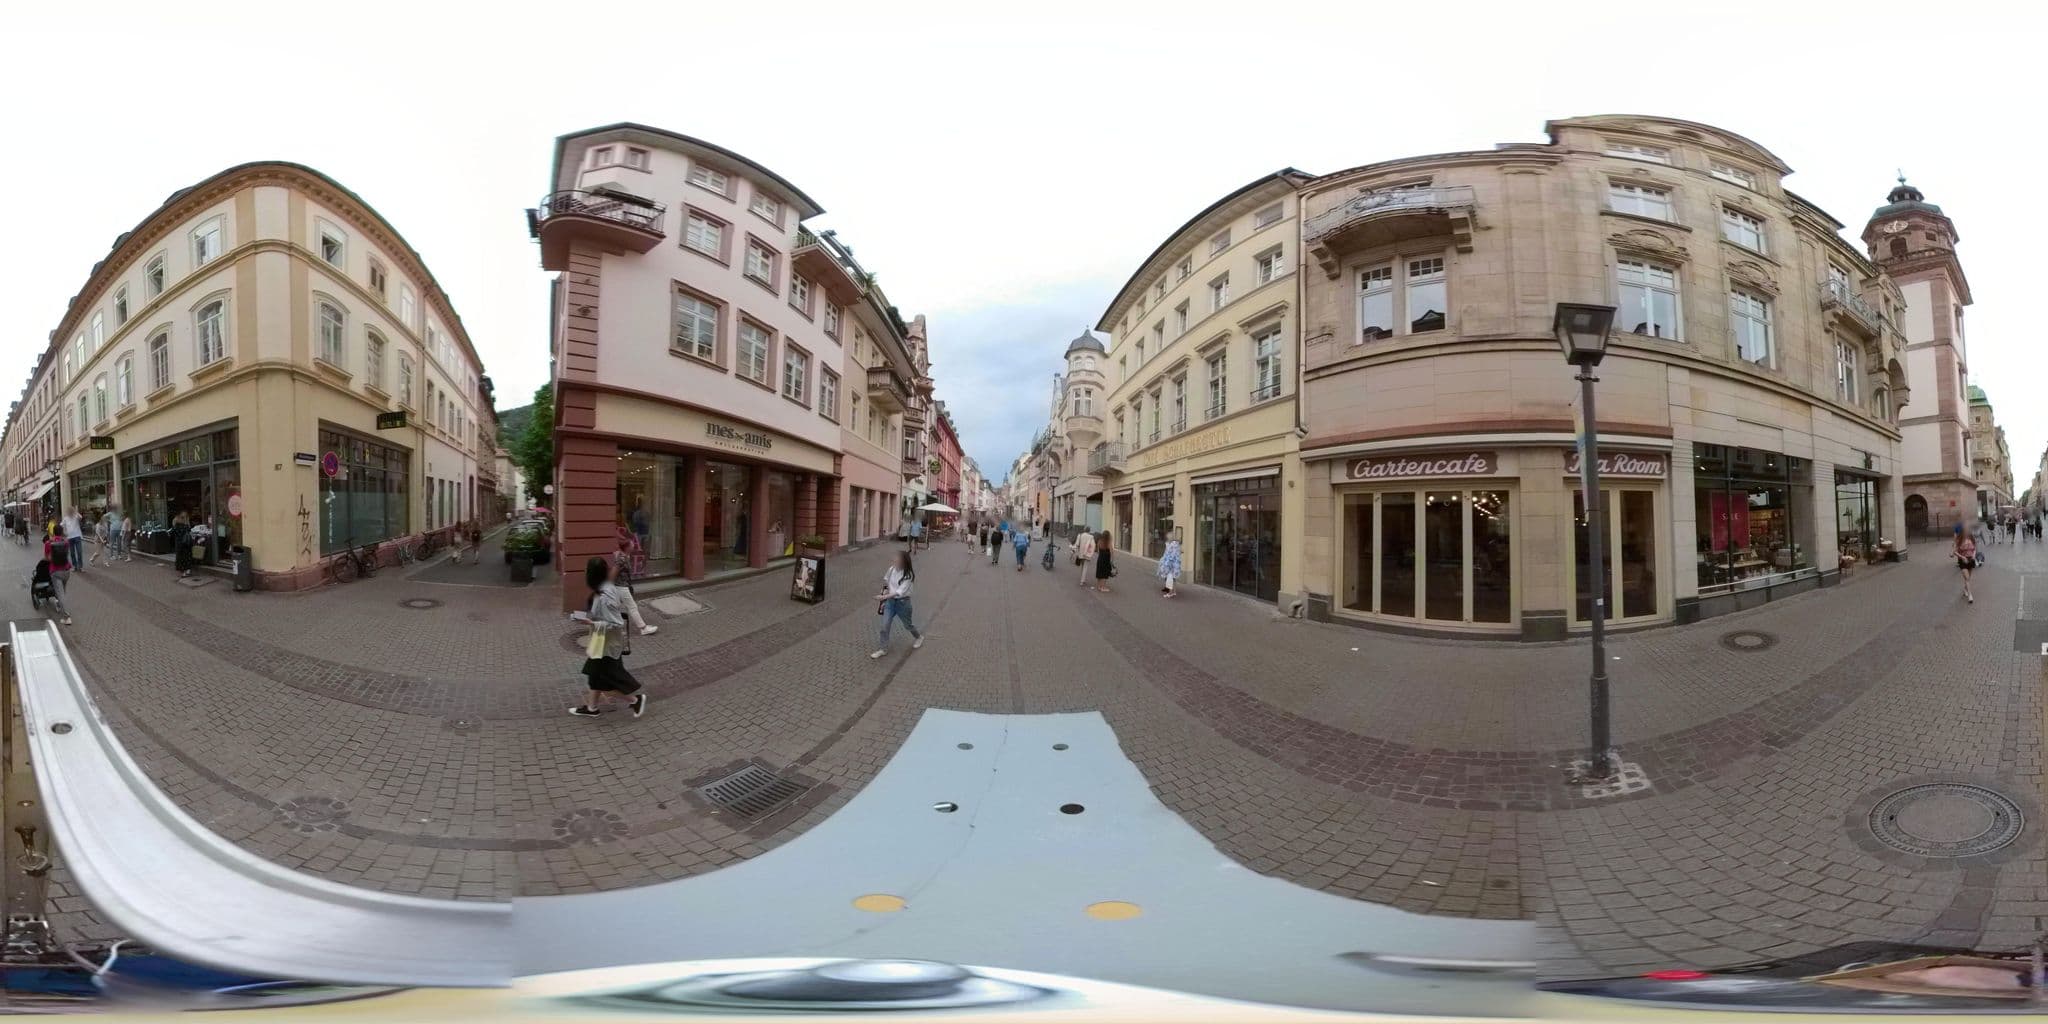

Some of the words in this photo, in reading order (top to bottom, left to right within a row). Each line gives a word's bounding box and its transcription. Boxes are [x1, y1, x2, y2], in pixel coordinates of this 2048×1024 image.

[706, 422, 735, 439] mes
[744, 432, 772, 448] amis
[1353, 453, 1488, 478] Gartencafe
[1612, 453, 1662, 474] Room
